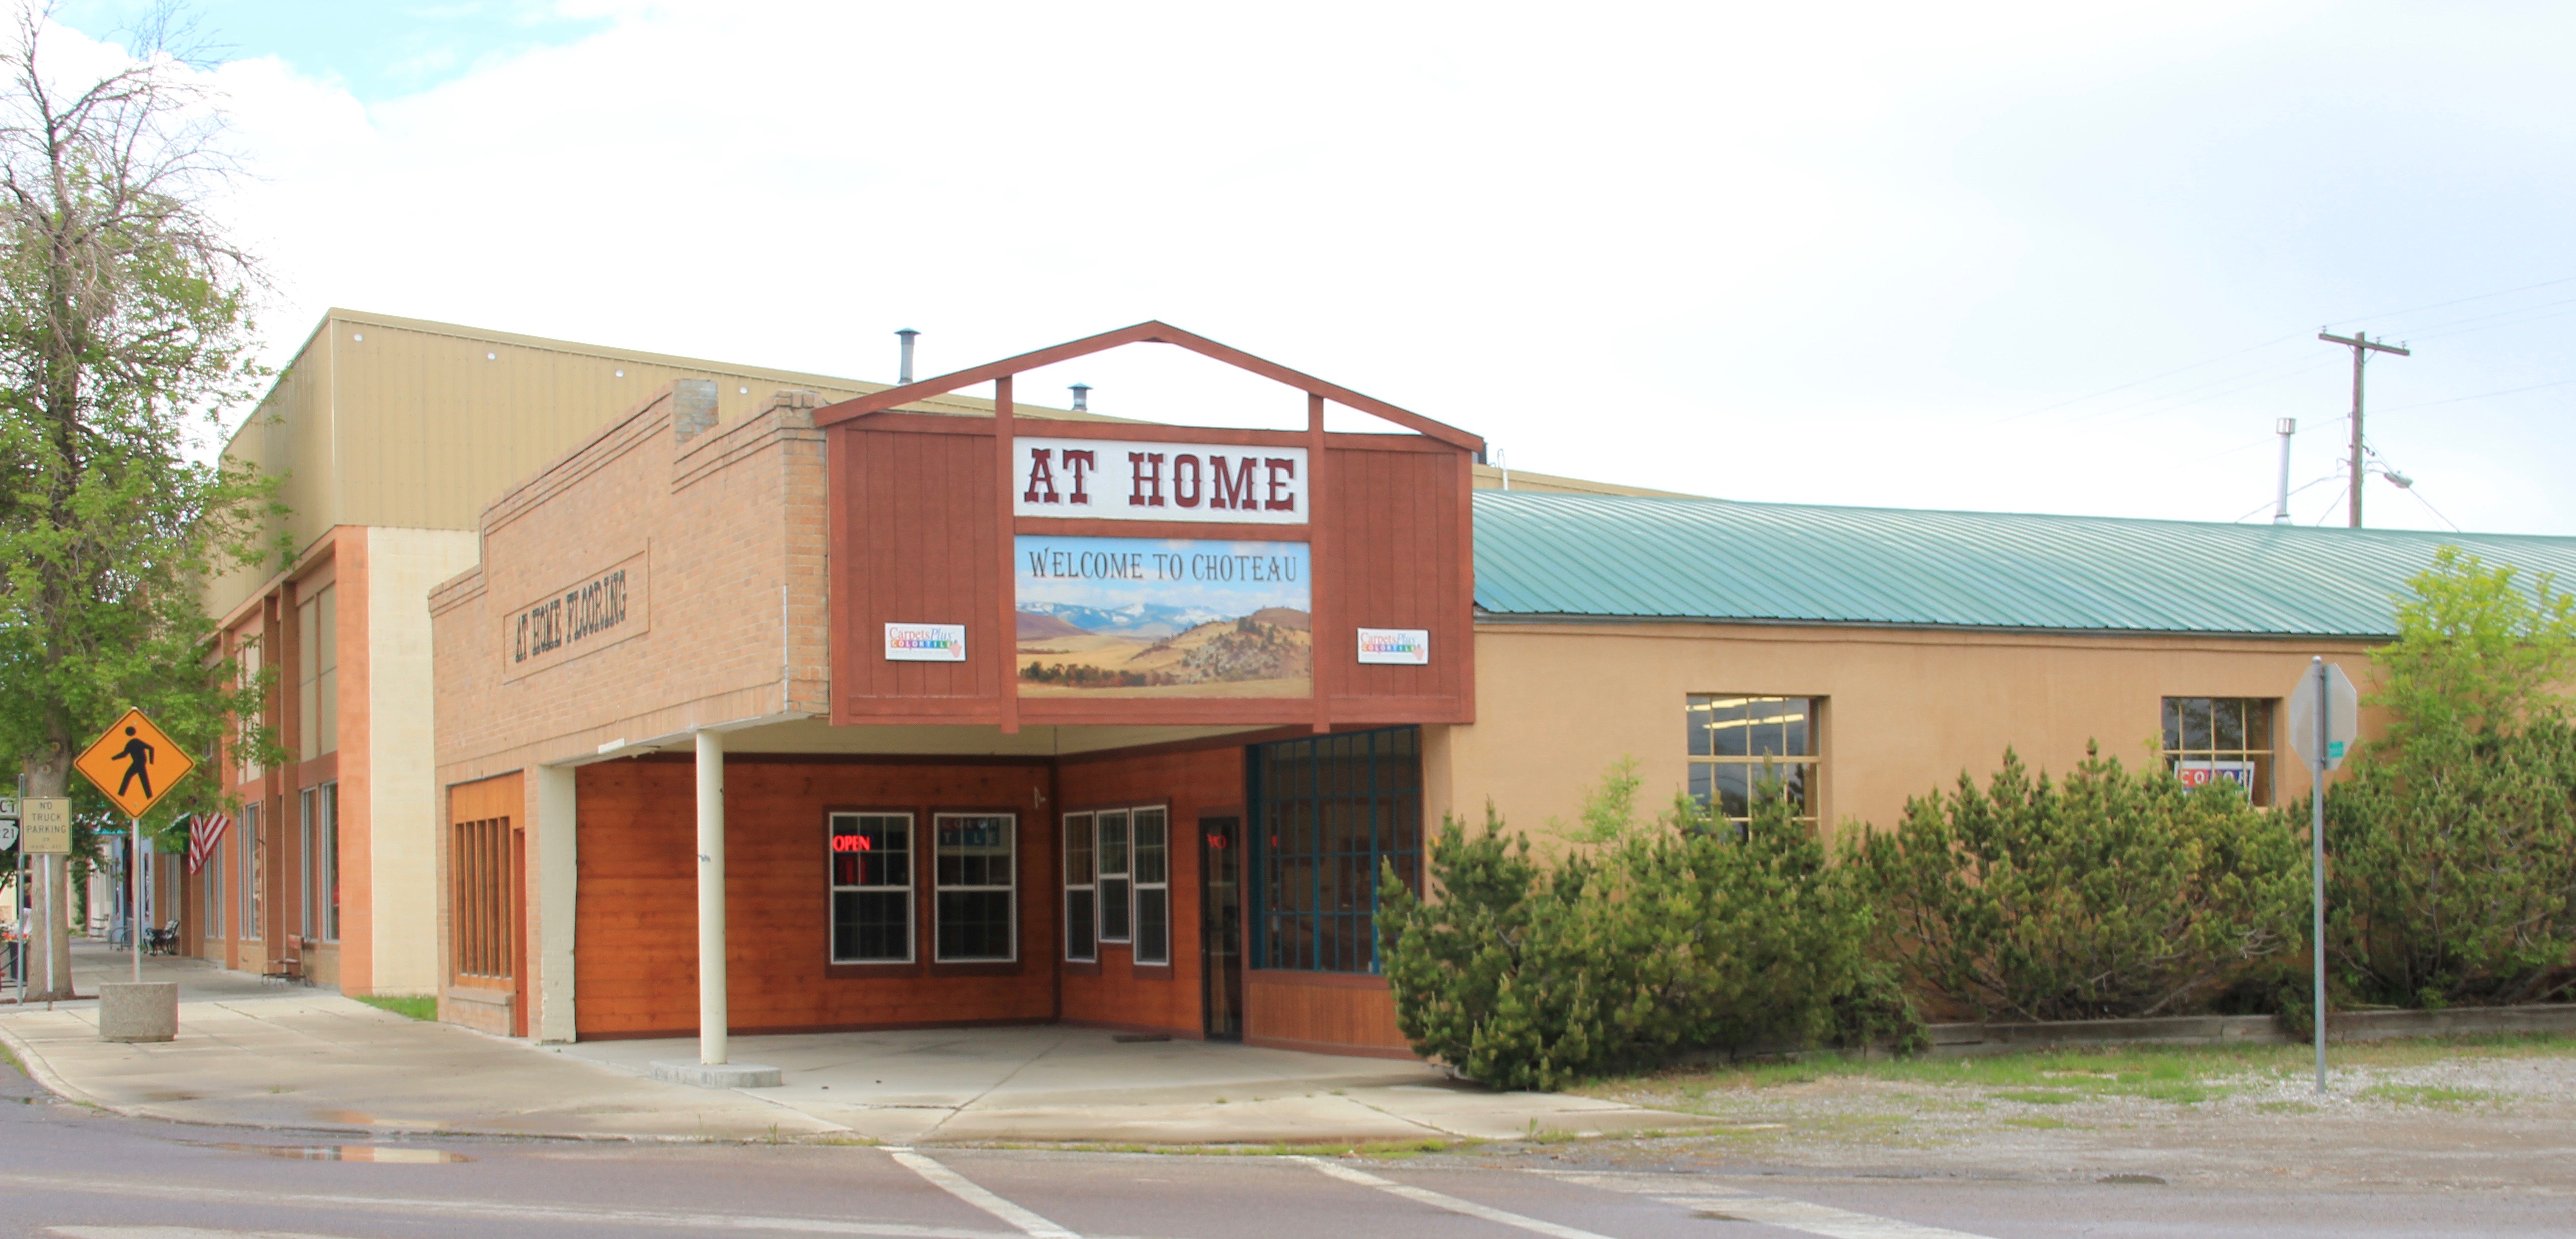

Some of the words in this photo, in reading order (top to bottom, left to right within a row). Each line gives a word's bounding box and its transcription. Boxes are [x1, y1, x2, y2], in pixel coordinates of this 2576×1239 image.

[1024, 448, 1094, 504] AT
[1128, 452, 1294, 511] HOME
[1029, 546, 1143, 579] WELCOME
[1152, 553, 1183, 580] TO
[1192, 553, 1297, 582] CHOTEAU
[516, 613, 529, 663] AT
[532, 598, 562, 657] HOME
[567, 569, 627, 644] FLOORING
[40, 801, 53, 810] NO
[32, 813, 62, 821] TRUCK
[26, 825, 66, 833] PARKING
[832, 834, 871, 852] OPEN
